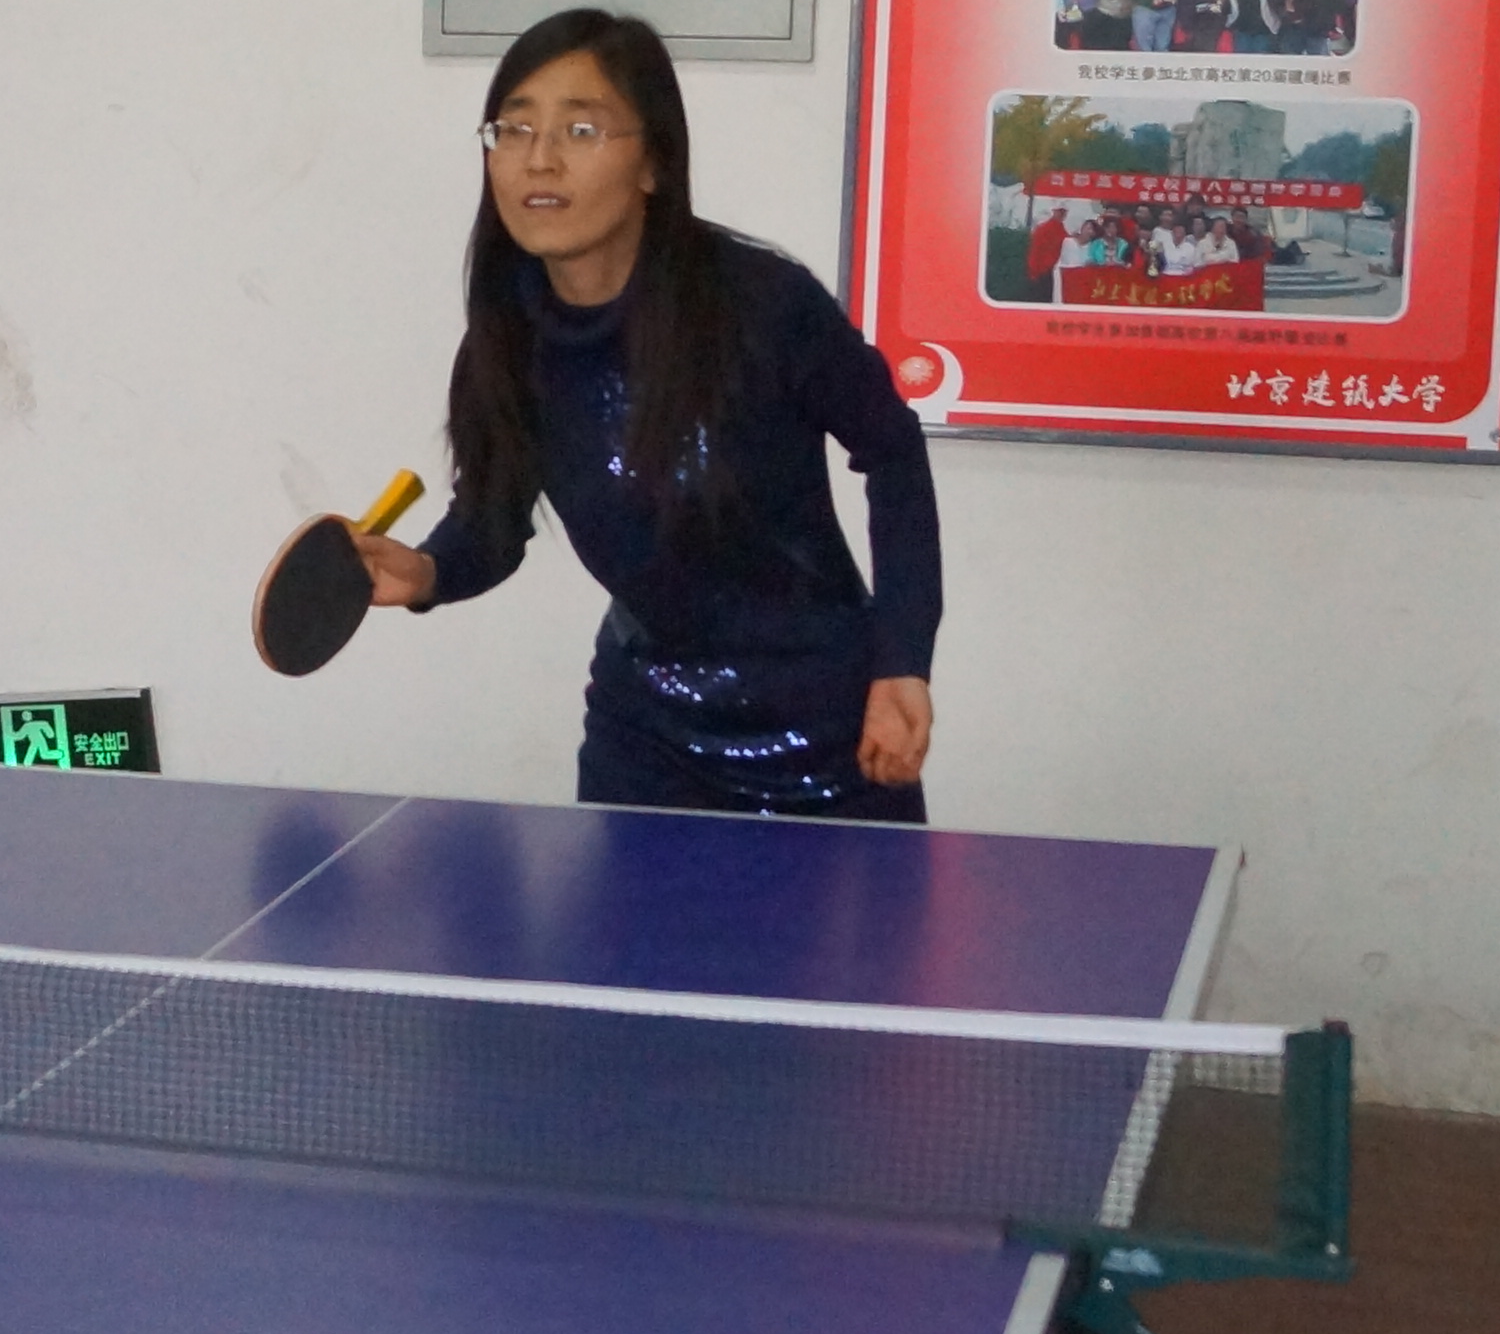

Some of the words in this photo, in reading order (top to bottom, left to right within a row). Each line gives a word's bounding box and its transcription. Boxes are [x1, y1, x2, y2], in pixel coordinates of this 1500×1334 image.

[1226, 368, 1446, 413] 北京建筑大学
[73, 731, 129, 752] 安全出口
[84, 751, 122, 766] EXIT
